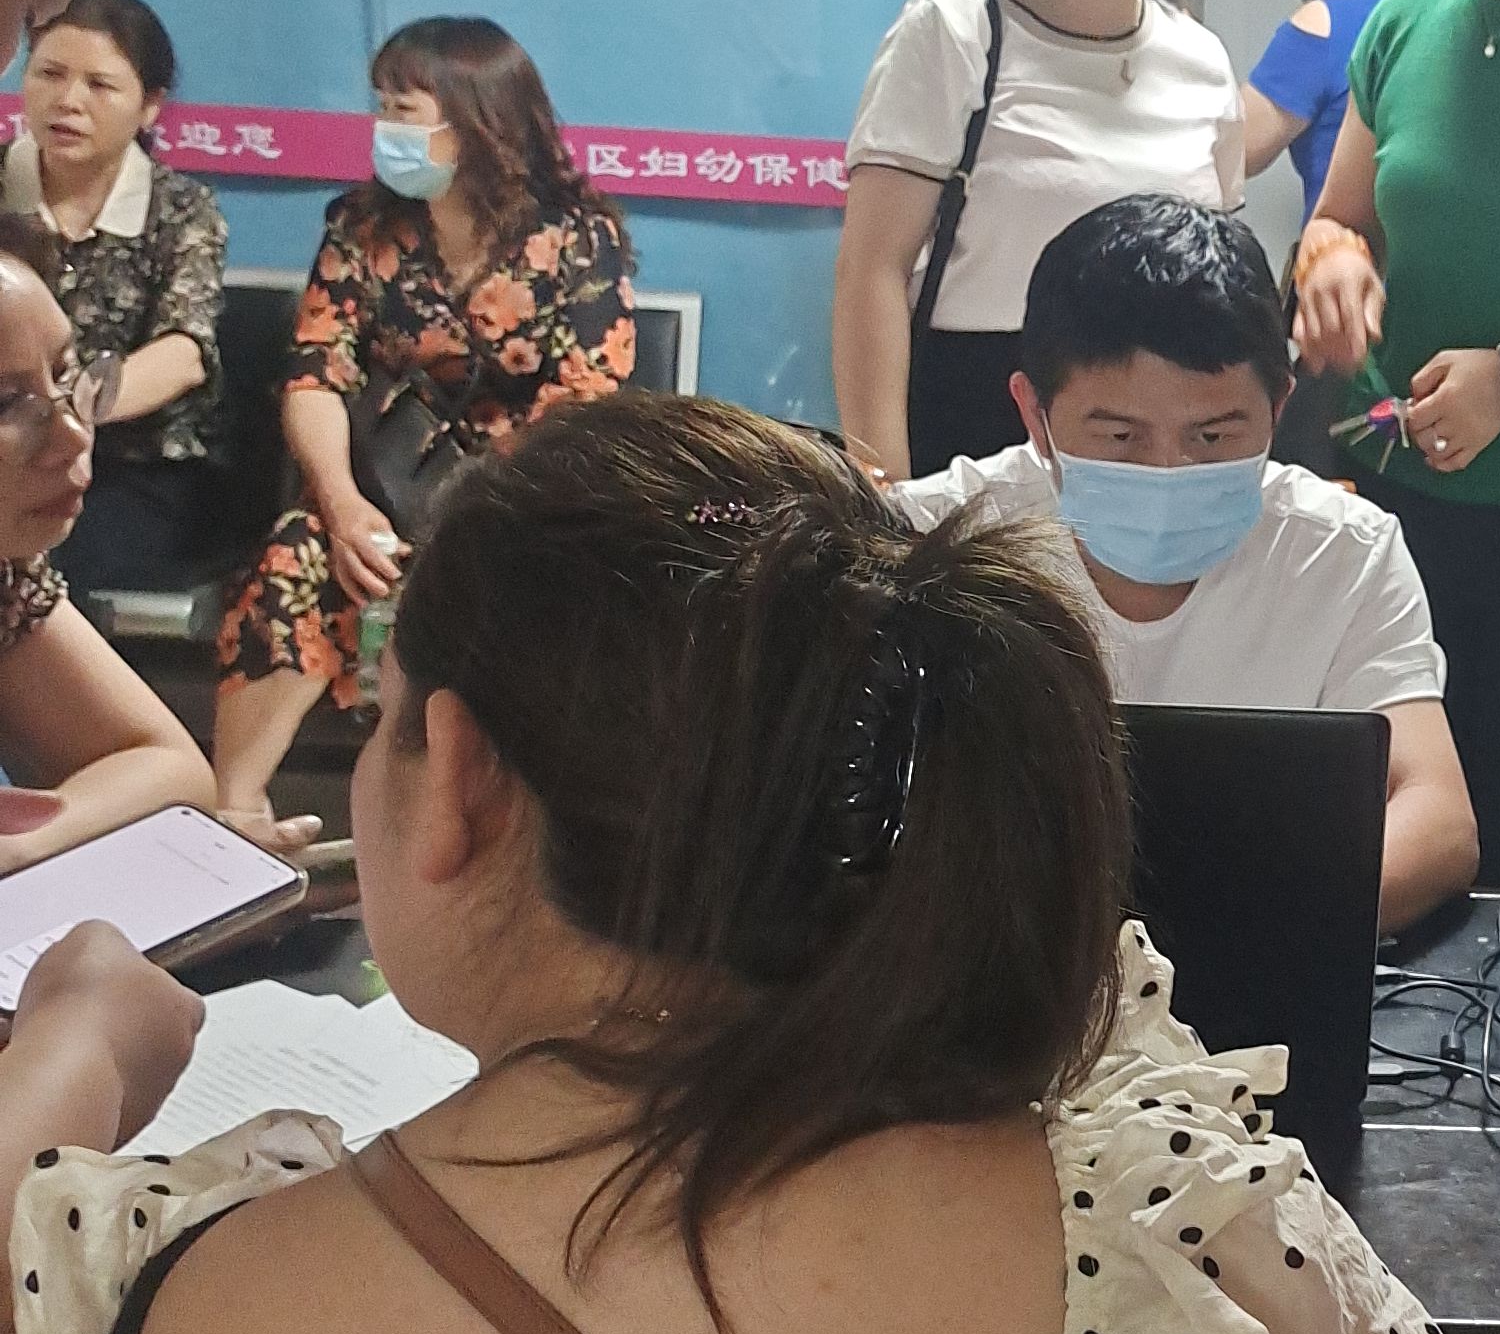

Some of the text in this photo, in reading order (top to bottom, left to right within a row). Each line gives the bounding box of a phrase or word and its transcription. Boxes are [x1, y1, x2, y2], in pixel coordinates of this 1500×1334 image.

[567, 143, 850, 191] 区妇幼保健
